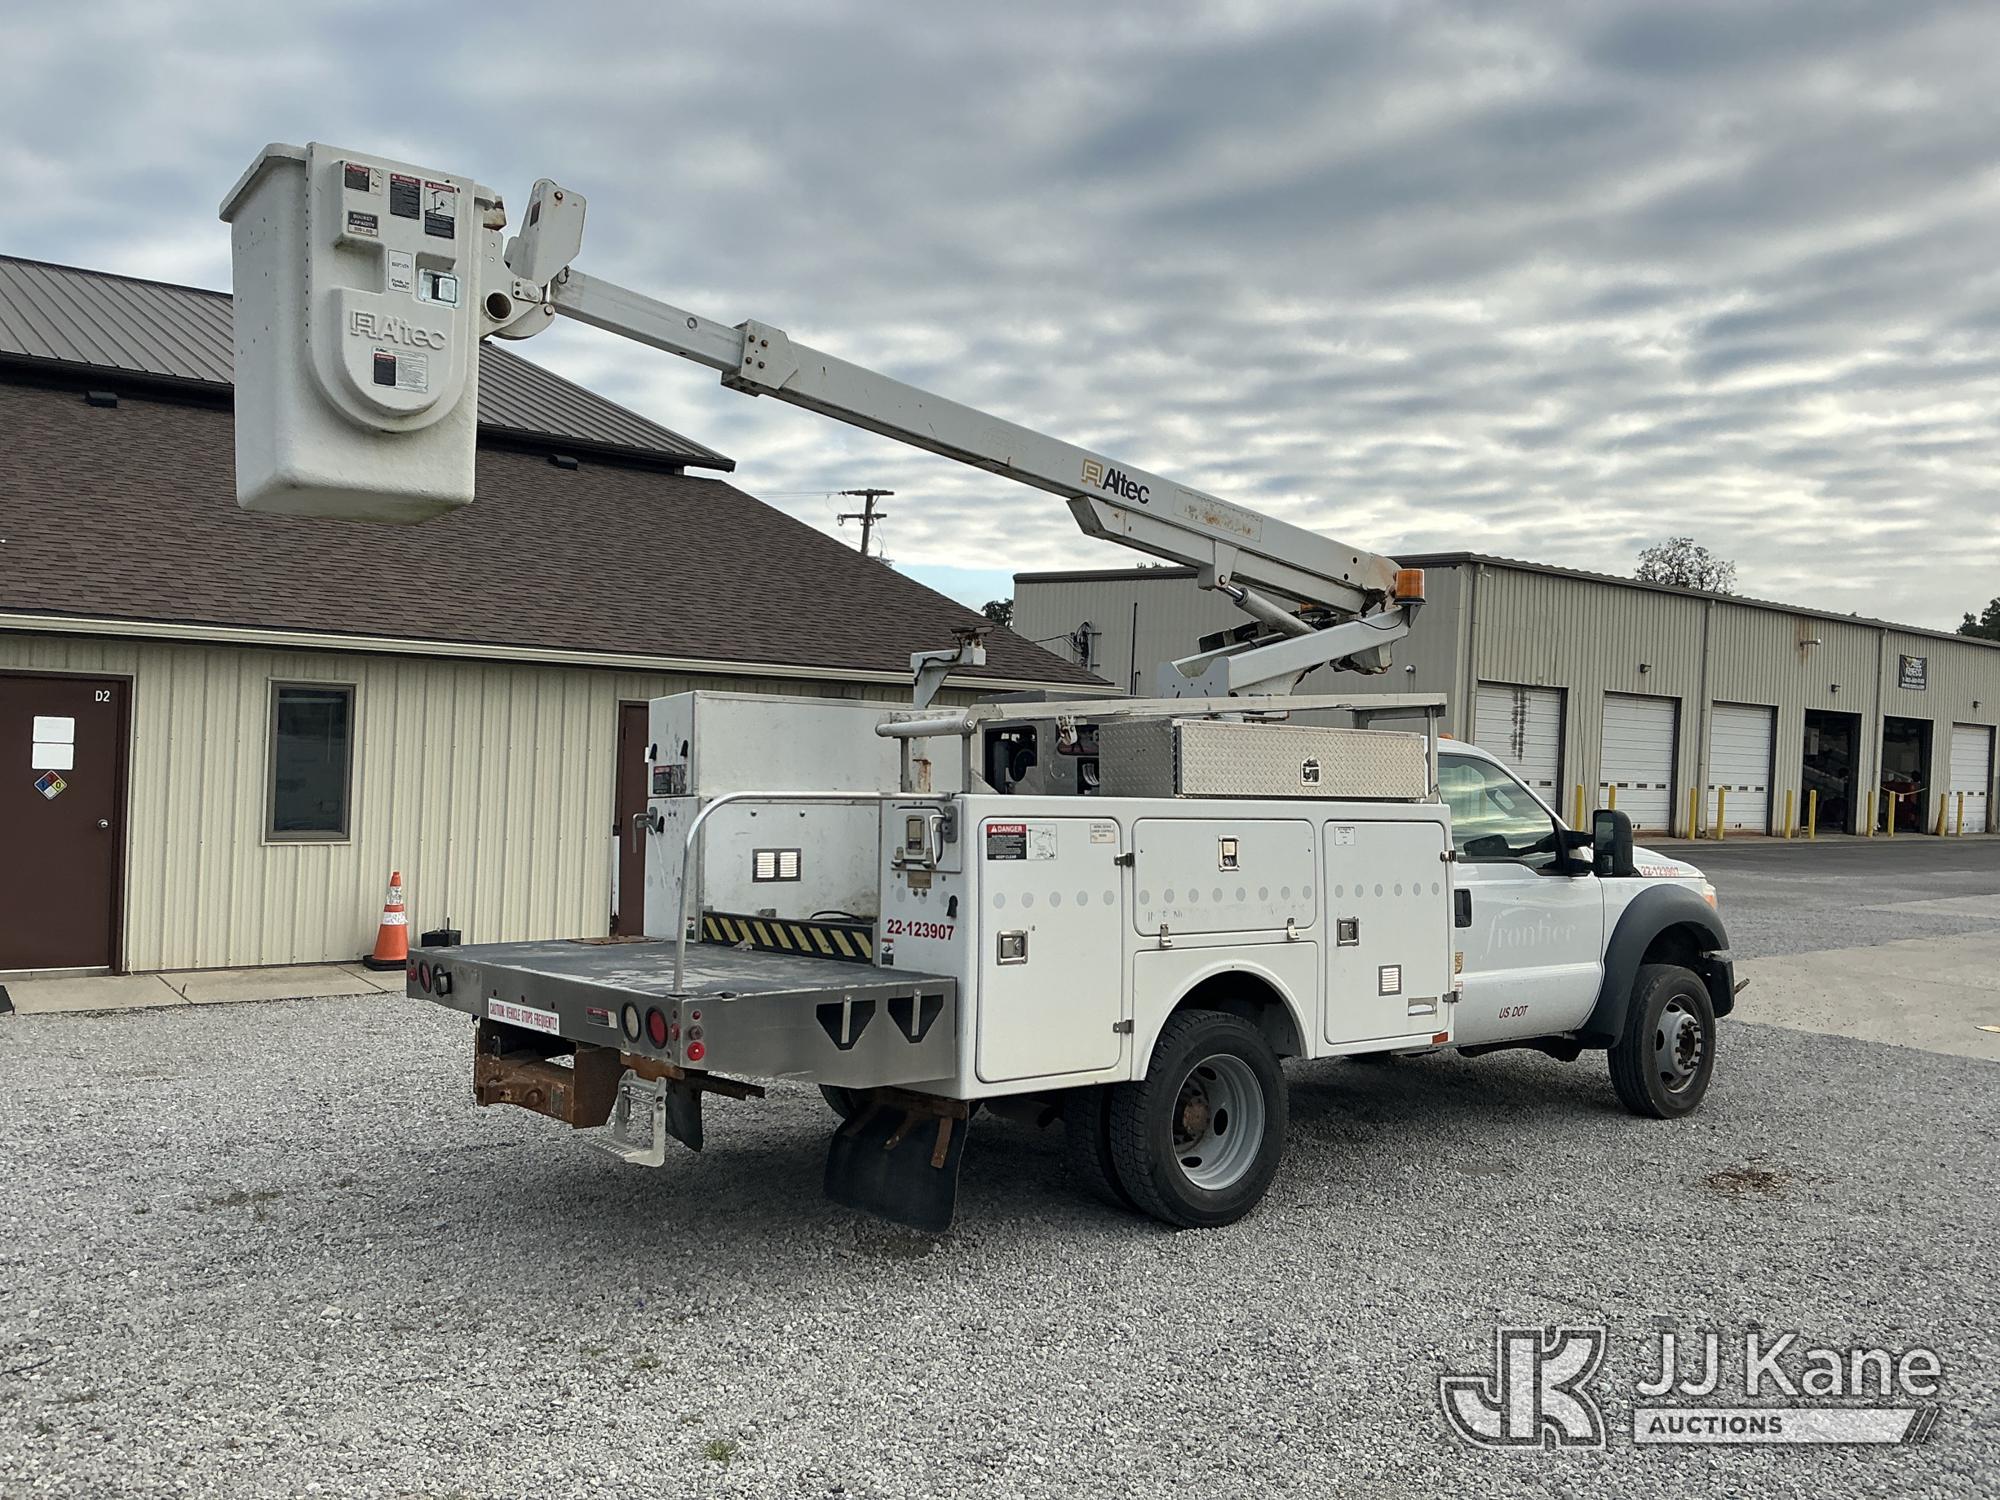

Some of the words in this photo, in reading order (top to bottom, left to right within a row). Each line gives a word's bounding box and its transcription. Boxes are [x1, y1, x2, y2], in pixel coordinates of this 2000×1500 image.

[378, 313, 446, 351] Altec
[1102, 467, 1150, 505] Altec
[95, 690, 110, 702] D2
[997, 825, 1023, 833] DANGER
[887, 919, 954, 940] 22-123907
[506, 1006, 521, 1022] VEHICLE
[521, 1010, 534, 1025] STOPS
[1499, 1007, 1511, 1019] US
[1511, 1005, 1529, 1017] DOT
